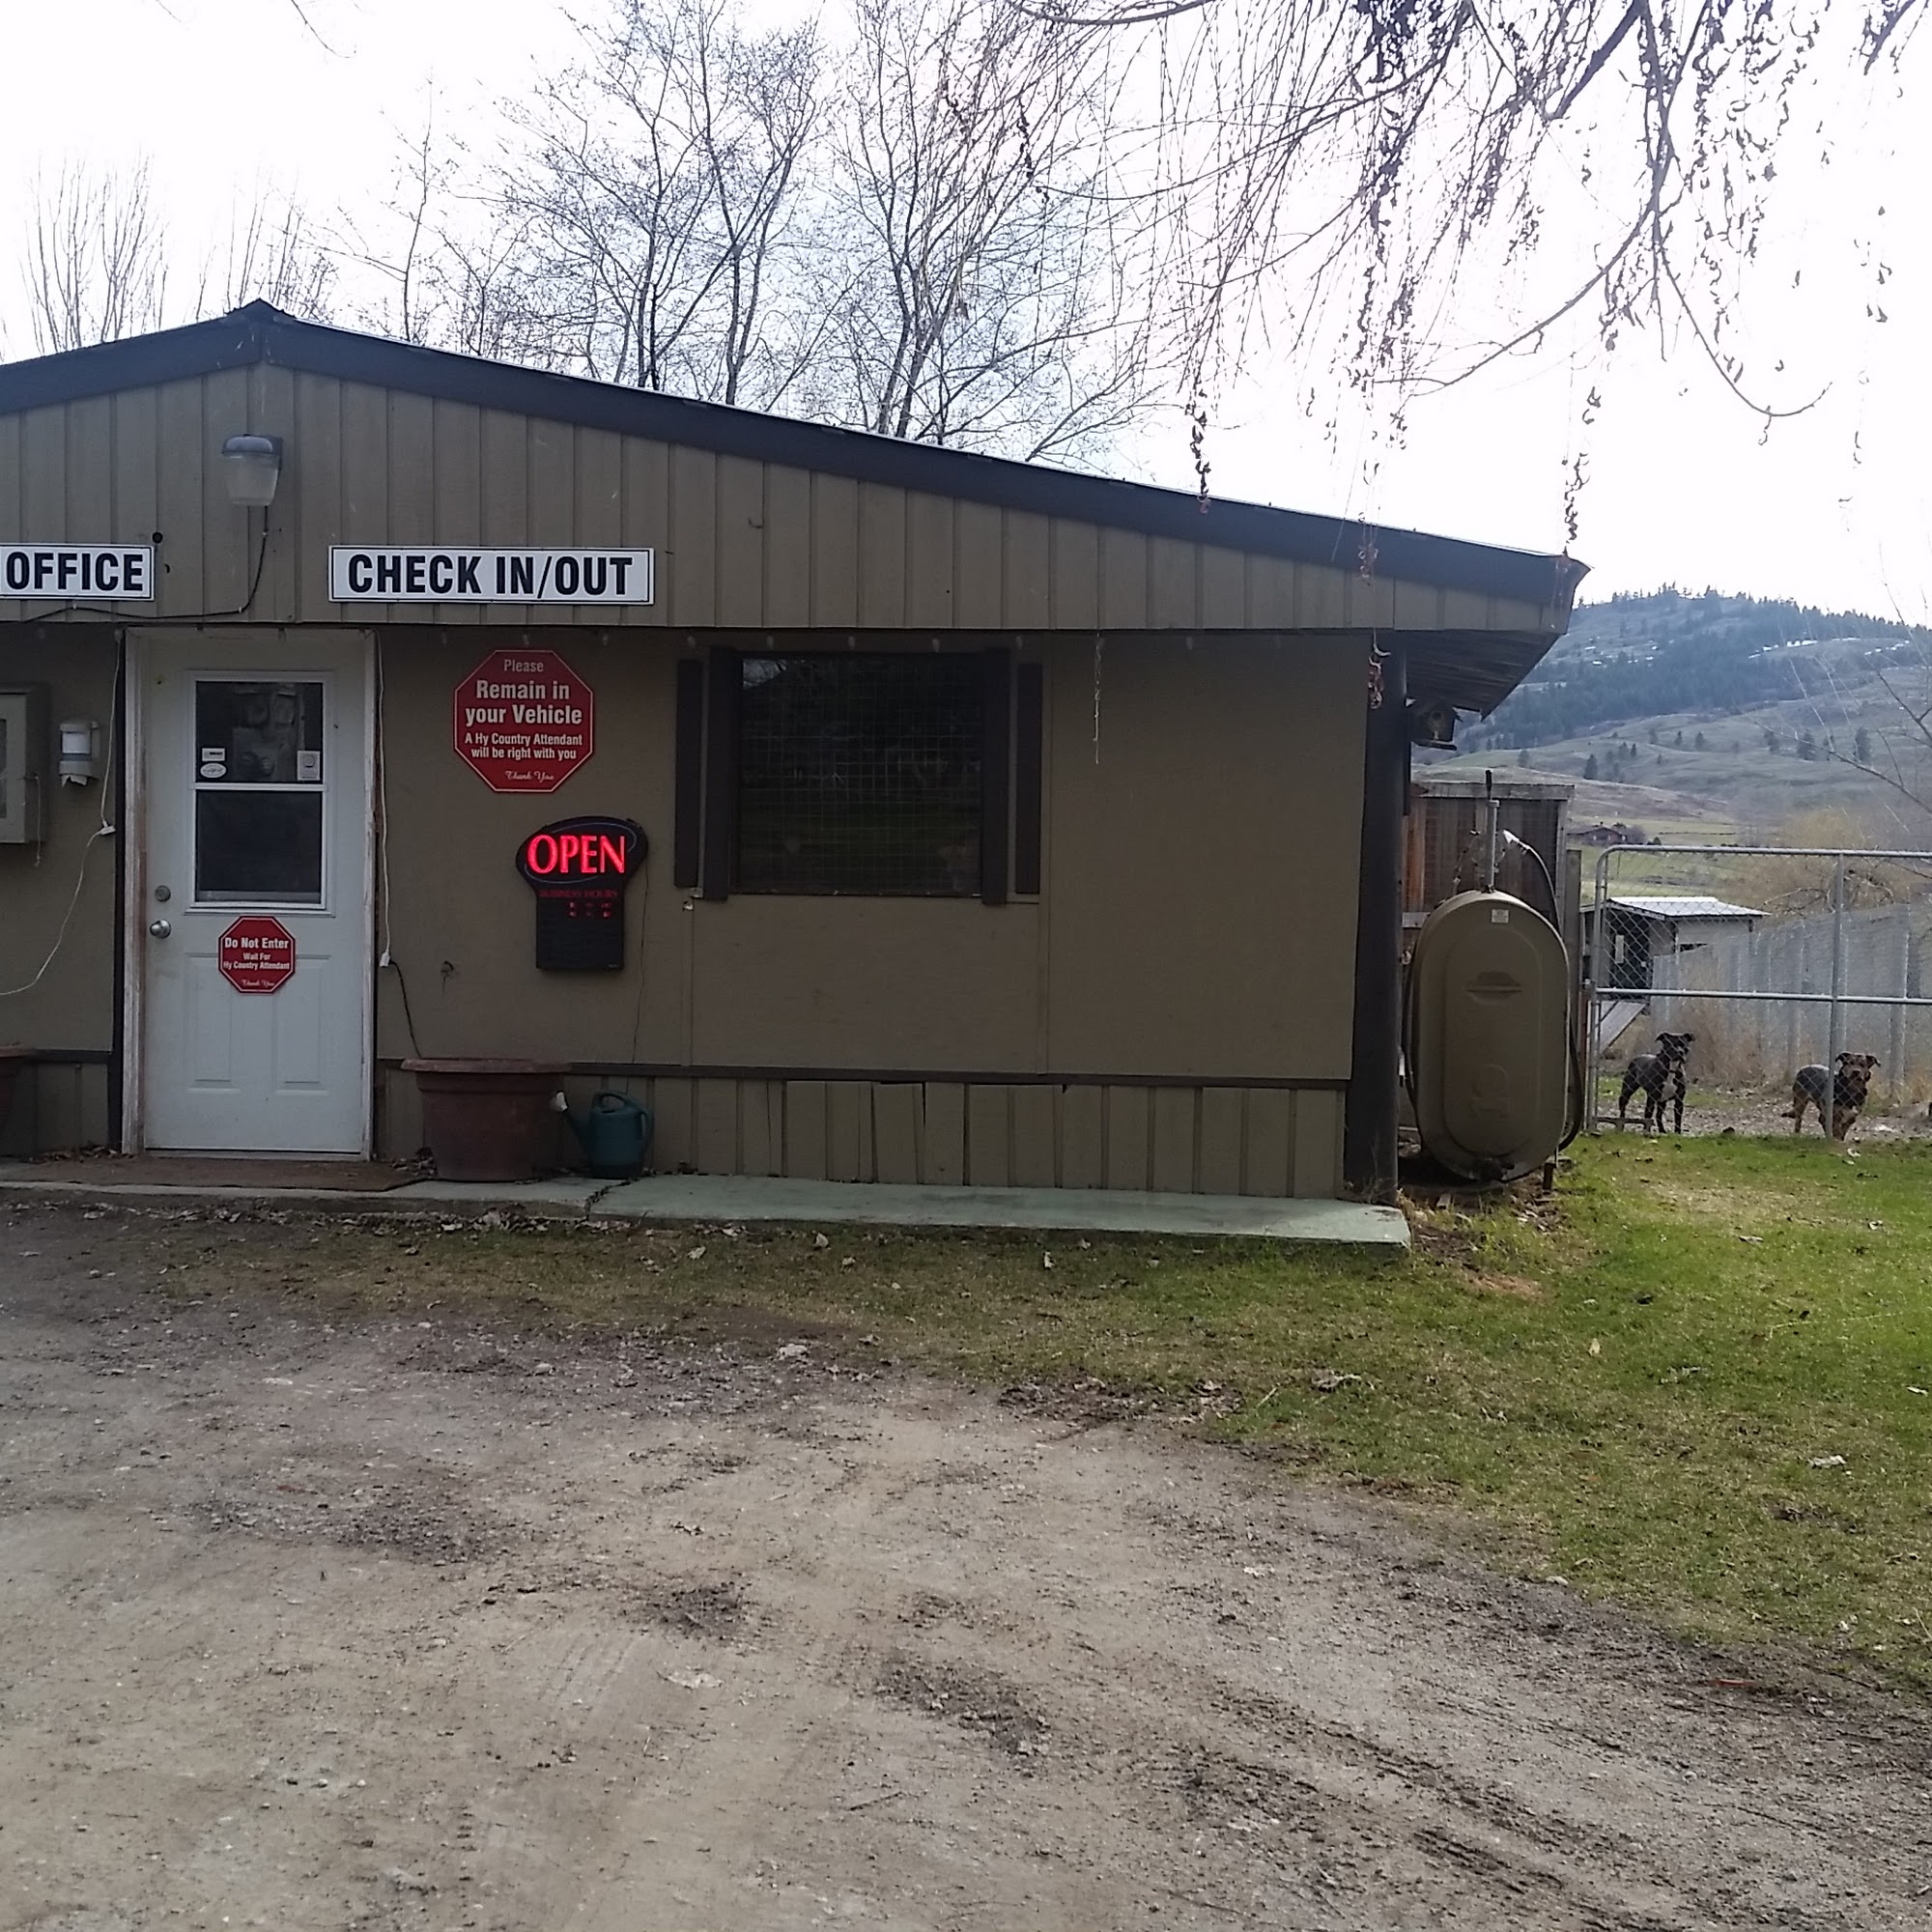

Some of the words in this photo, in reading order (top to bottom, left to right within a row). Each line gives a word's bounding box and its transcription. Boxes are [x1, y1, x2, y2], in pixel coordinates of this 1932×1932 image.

[6, 551, 143, 591] OFFICE
[348, 554, 482, 594] CHECK
[496, 555, 633, 599] IN/OUT
[503, 659, 544, 672] Please
[476, 679, 546, 699] Remain
[553, 680, 570, 699] in
[465, 706, 507, 727] your
[512, 704, 582, 724] Vehicle
[465, 732, 473, 744] A
[475, 732, 489, 747] Hy
[491, 733, 531, 747] Country
[533, 733, 582, 746] Attendant
[470, 747, 490, 758] will
[492, 747, 504, 758] be
[507, 747, 531, 761] right
[533, 748, 555, 759] with
[557, 750, 577, 761] you
[504, 770, 532, 781] Thank
[533, 771, 554, 783] You
[526, 834, 626, 874] OPEN
[224, 937, 239, 949] Do
[241, 937, 259, 949] Not
[261, 937, 289, 949] Enter
[233, 961, 259, 971] Country
[259, 961, 290, 970] Attendant
